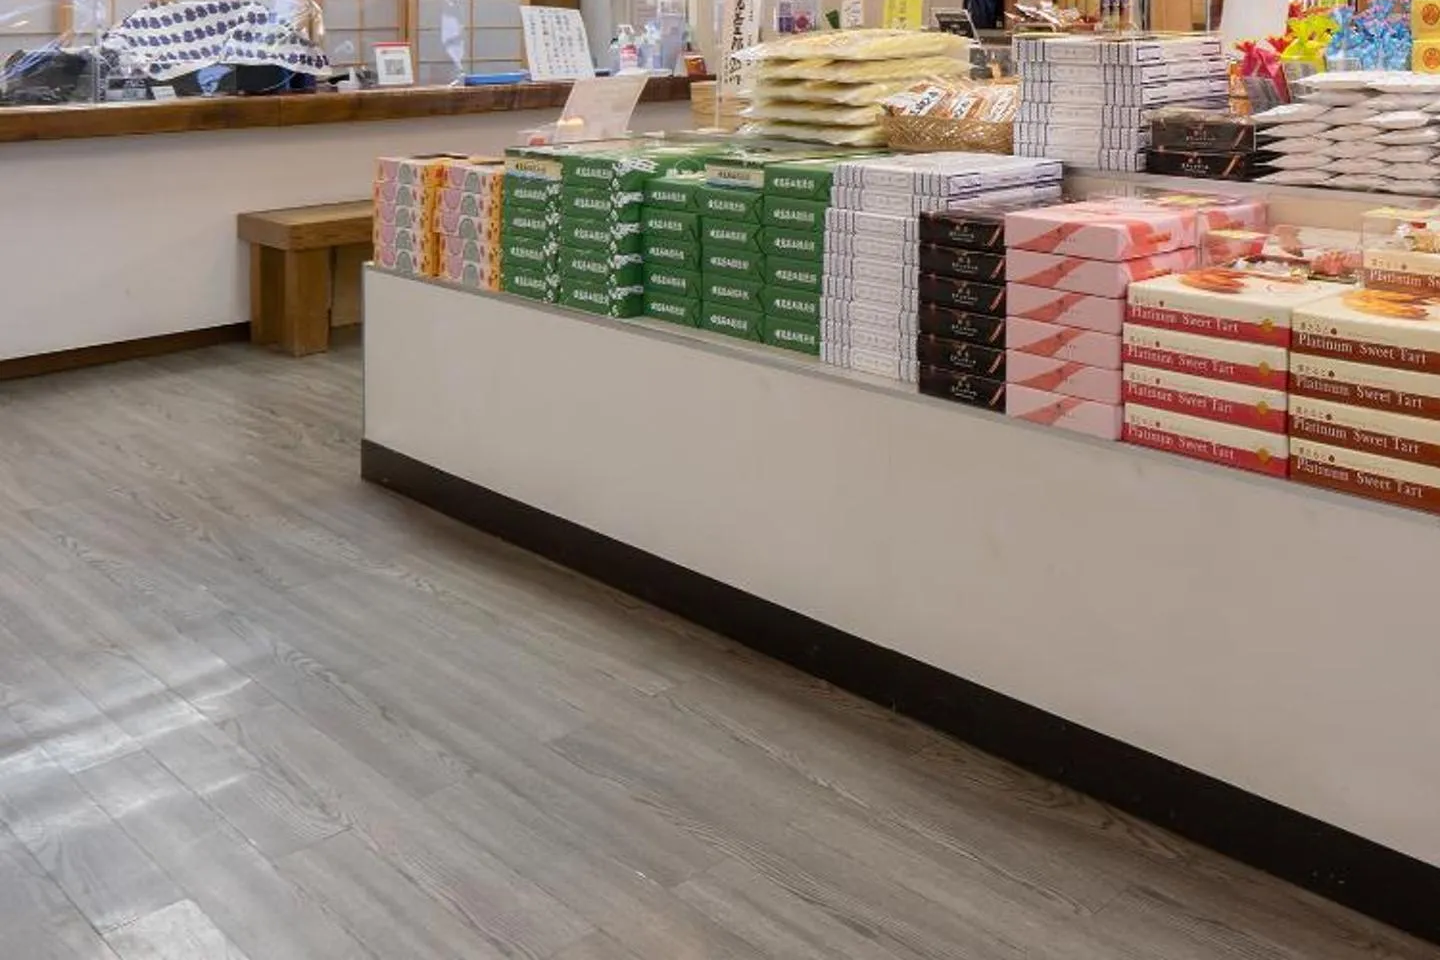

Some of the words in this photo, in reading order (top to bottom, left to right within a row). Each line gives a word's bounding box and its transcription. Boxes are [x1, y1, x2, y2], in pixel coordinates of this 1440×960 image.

[1299, 333, 1353, 353] Platinum
[1359, 343, 1394, 360] Sweet
[1356, 385, 1391, 404] Sweet
[1397, 391, 1424, 409] Tart
[1293, 416, 1347, 439] Platinum
[1353, 429, 1388, 448] Sweet
[1392, 437, 1420, 455] Tart
[1356, 472, 1391, 492] Sweet
[1397, 481, 1424, 499] Tart
